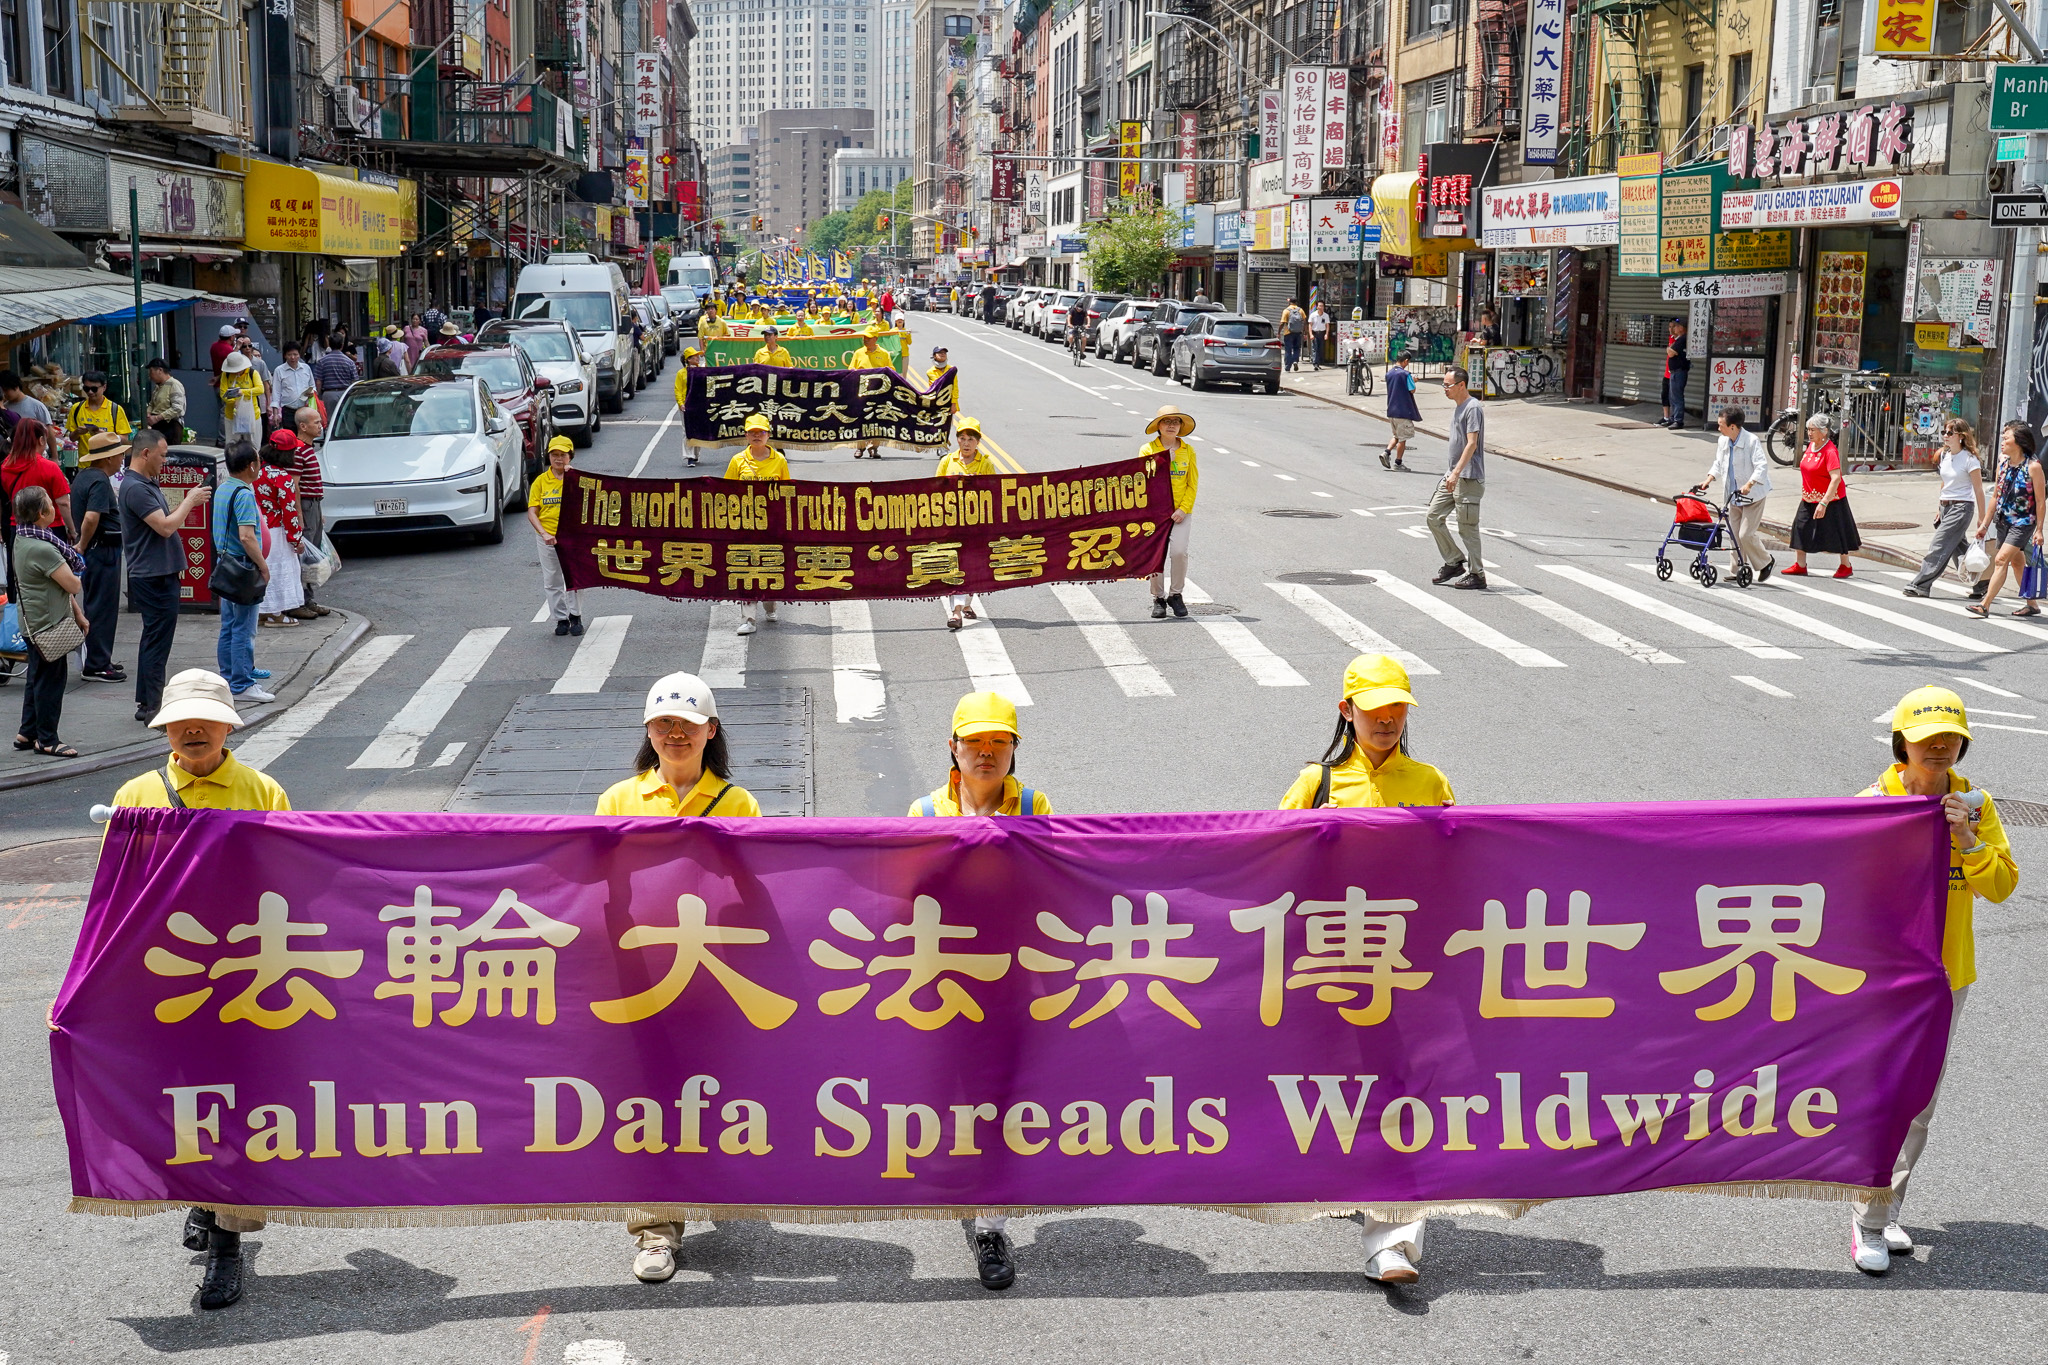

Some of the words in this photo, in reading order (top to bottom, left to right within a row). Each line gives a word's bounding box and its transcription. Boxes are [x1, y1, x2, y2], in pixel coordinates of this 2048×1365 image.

[1883, 0, 1926, 47] 家
[2010, 102, 2028, 118] Br
[1728, 100, 1908, 179] 國惠海鮮酒家
[1334, 201, 1350, 214] 福
[1561, 192, 1596, 214] PHARMACY
[1596, 191, 1608, 211] INC
[1754, 194, 1774, 210] JUFU
[1775, 190, 1806, 210] GARDEN
[1808, 186, 1864, 206] RESTAURANT
[2002, 204, 2026, 216] ONE
[267, 216, 318, 228] 福州小吃店
[270, 229, 317, 238] 646-326-8810
[1319, 216, 1334, 228] 大
[714, 352, 754, 368] FALU
[792, 358, 818, 368] ONG
[823, 358, 836, 368] IS
[706, 373, 840, 398] Falun
[707, 399, 951, 427] 法輪大法好
[777, 424, 836, 440] Practice
[839, 424, 859, 440] for
[862, 423, 896, 438] Mind
[900, 427, 911, 440] &
[915, 428, 948, 445] Body
[579, 477, 621, 527] The
[629, 482, 693, 529] world
[854, 480, 994, 536] Compassion
[144, 883, 1867, 1030] 法輪大法洪傳世界
[162, 1080, 483, 1165] Falun
[524, 1074, 774, 1155] Dafa
[814, 1076, 1230, 1179] Spreads
[1268, 1064, 1838, 1155] Worldwide
